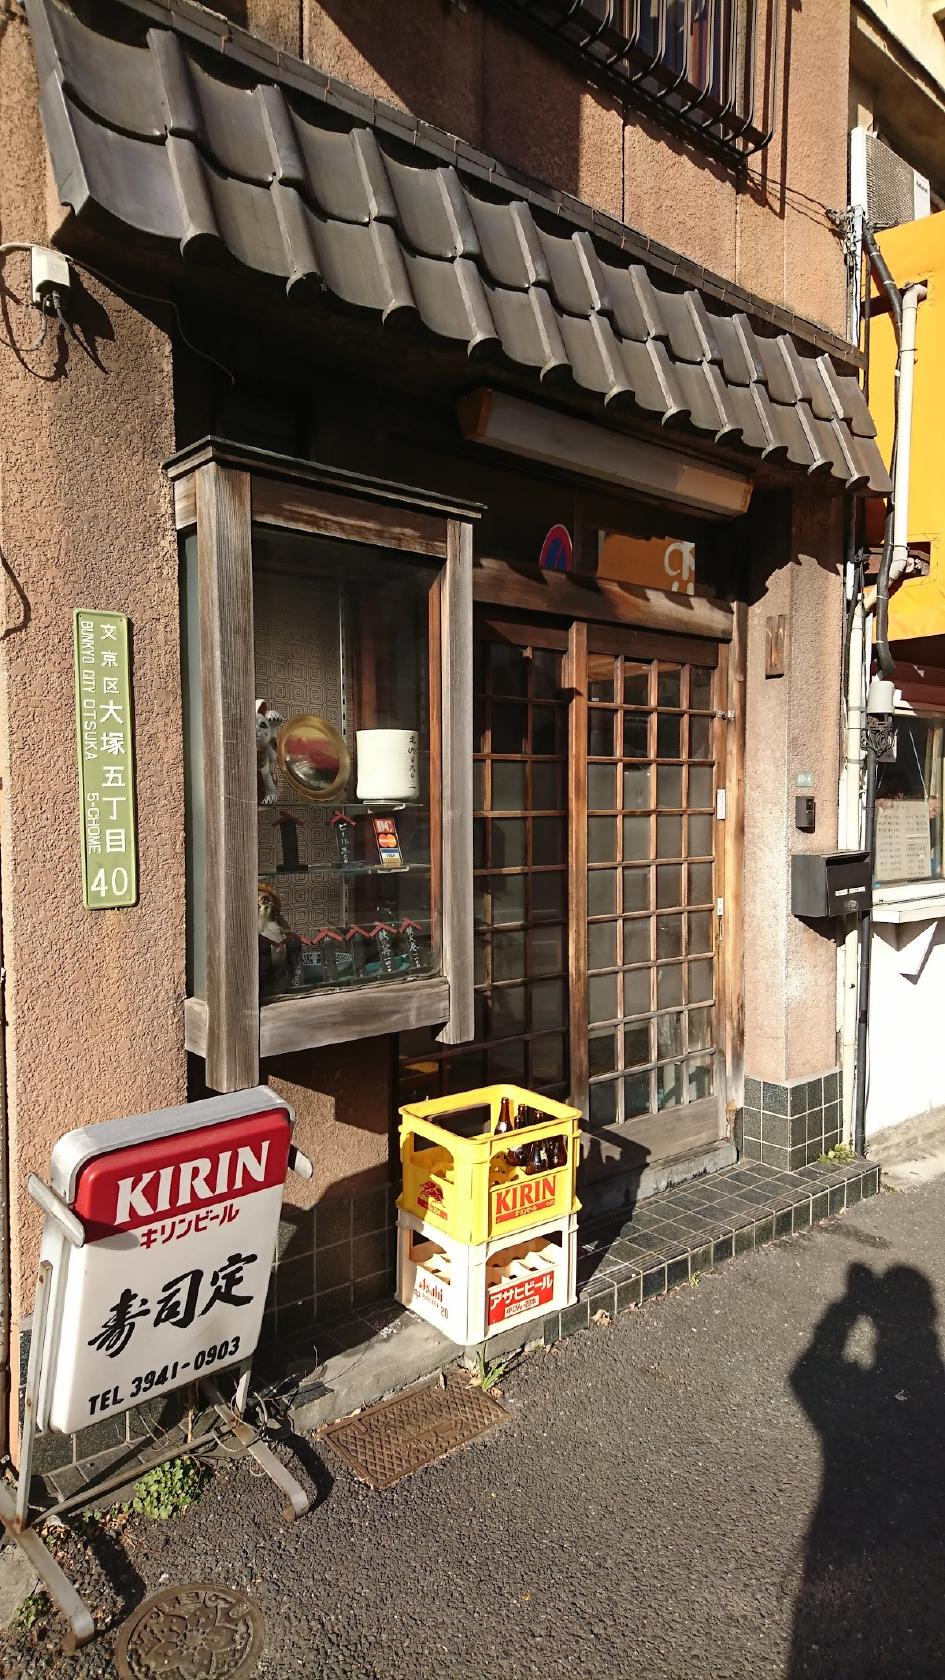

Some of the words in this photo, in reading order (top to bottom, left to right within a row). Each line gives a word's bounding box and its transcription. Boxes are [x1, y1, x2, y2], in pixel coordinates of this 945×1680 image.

[80, 620, 95, 664] BUNKYO
[82, 669, 97, 693] CITY
[83, 699, 98, 760] OTSUKA
[99, 623, 126, 853] 文京区大塚五丁目
[87, 792, 101, 855] 5-CHOME
[90, 867, 128, 897] 40
[113, 1140, 271, 1226] KIRIN
[495, 1175, 556, 1215] KIRIN
[139, 1203, 240, 1250] キリンビール
[87, 1252, 259, 1359] 寿司定
[418, 1278, 443, 1303] Asahi
[490, 1274, 553, 1311] アサヒビール
[87, 1385, 125, 1416] TEL
[130, 1336, 241, 1398] 3941-0903
